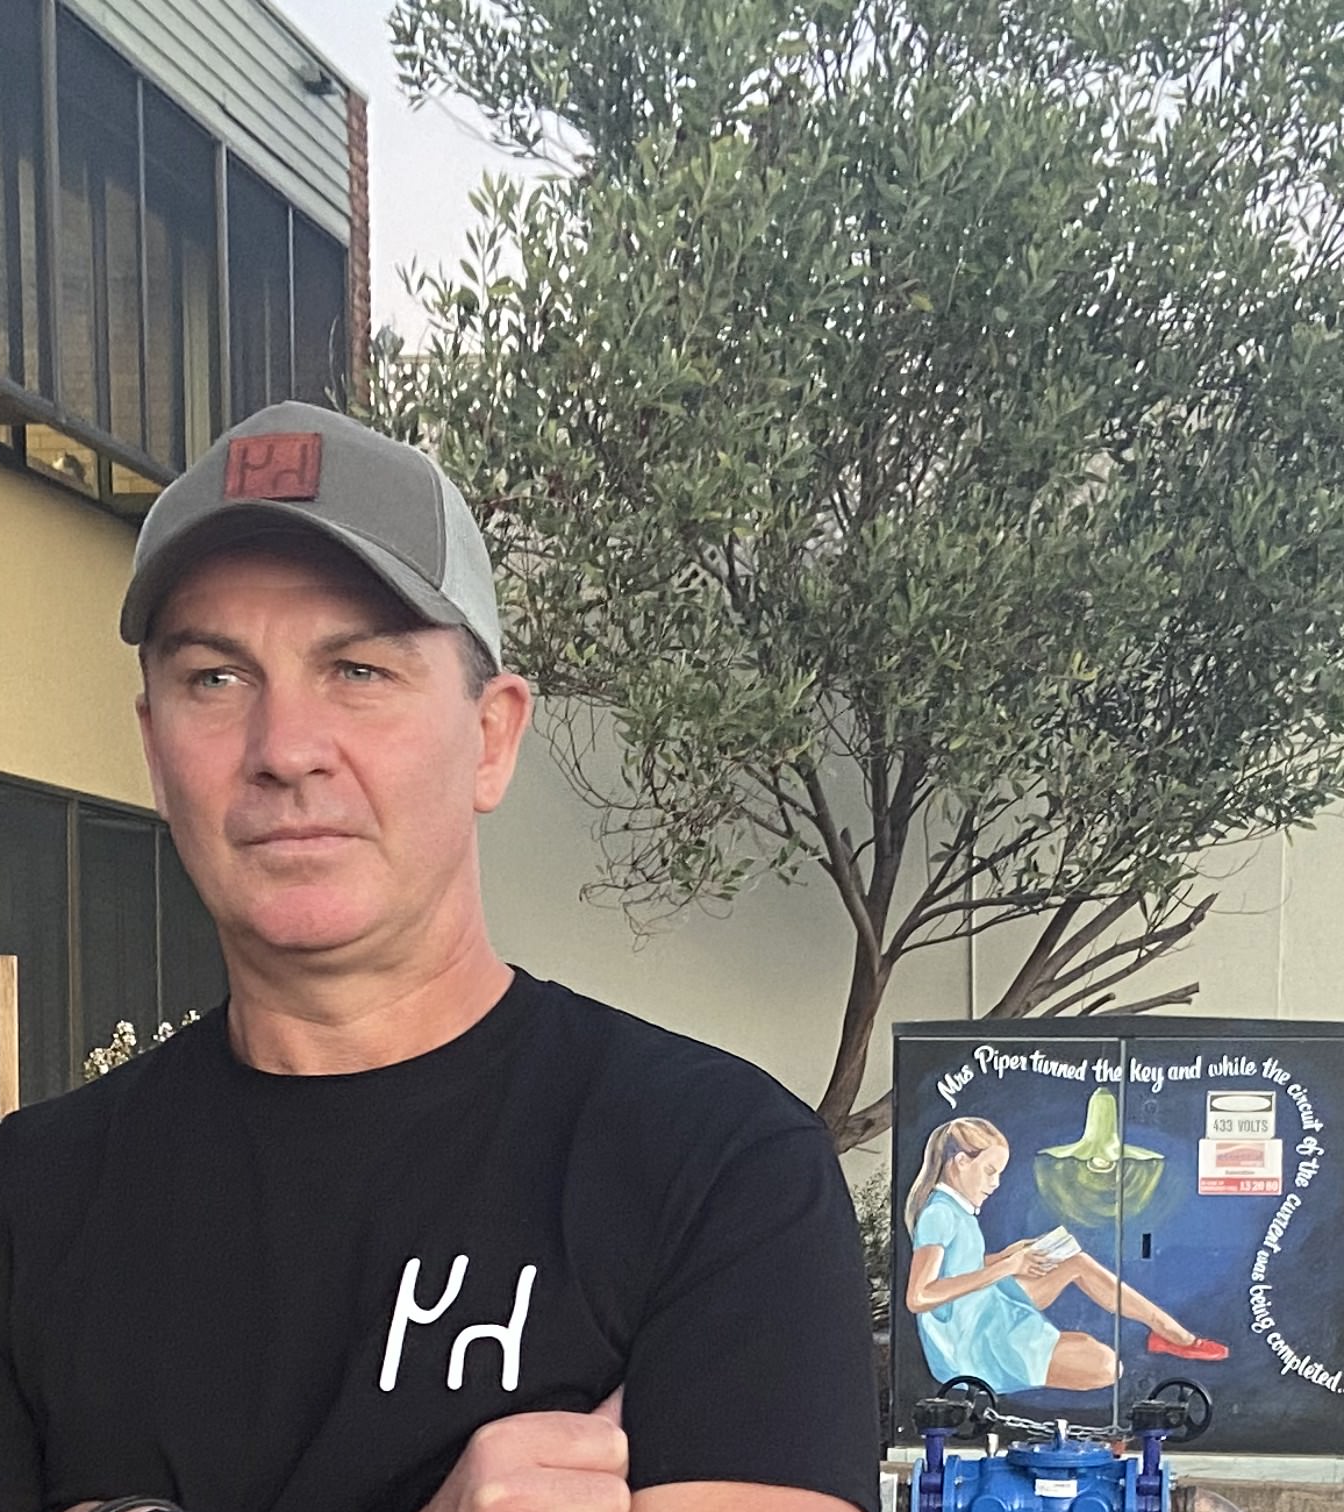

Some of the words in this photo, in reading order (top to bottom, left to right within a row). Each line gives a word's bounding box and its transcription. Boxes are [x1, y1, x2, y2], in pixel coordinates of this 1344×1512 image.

[974, 1045, 1027, 1079] Piper
[1029, 1050, 1088, 1082] turned
[1092, 1057, 1123, 1083] the
[1130, 1056, 1164, 1093] key
[1167, 1055, 1202, 1081] and
[1207, 1055, 1258, 1078] while
[1261, 1057, 1292, 1086] the
[937, 1064, 975, 1109] Mrs
[1286, 1083, 1324, 1132] circuit
[1212, 1119, 1234, 1133] 433
[1237, 1119, 1269, 1133] VOLTS
[1295, 1135, 1325, 1157] of
[1295, 1157, 1321, 1188] the
[1263, 1193, 1302, 1254] current
[1251, 1249, 1270, 1282] was
[1249, 1284, 1276, 1334] being
